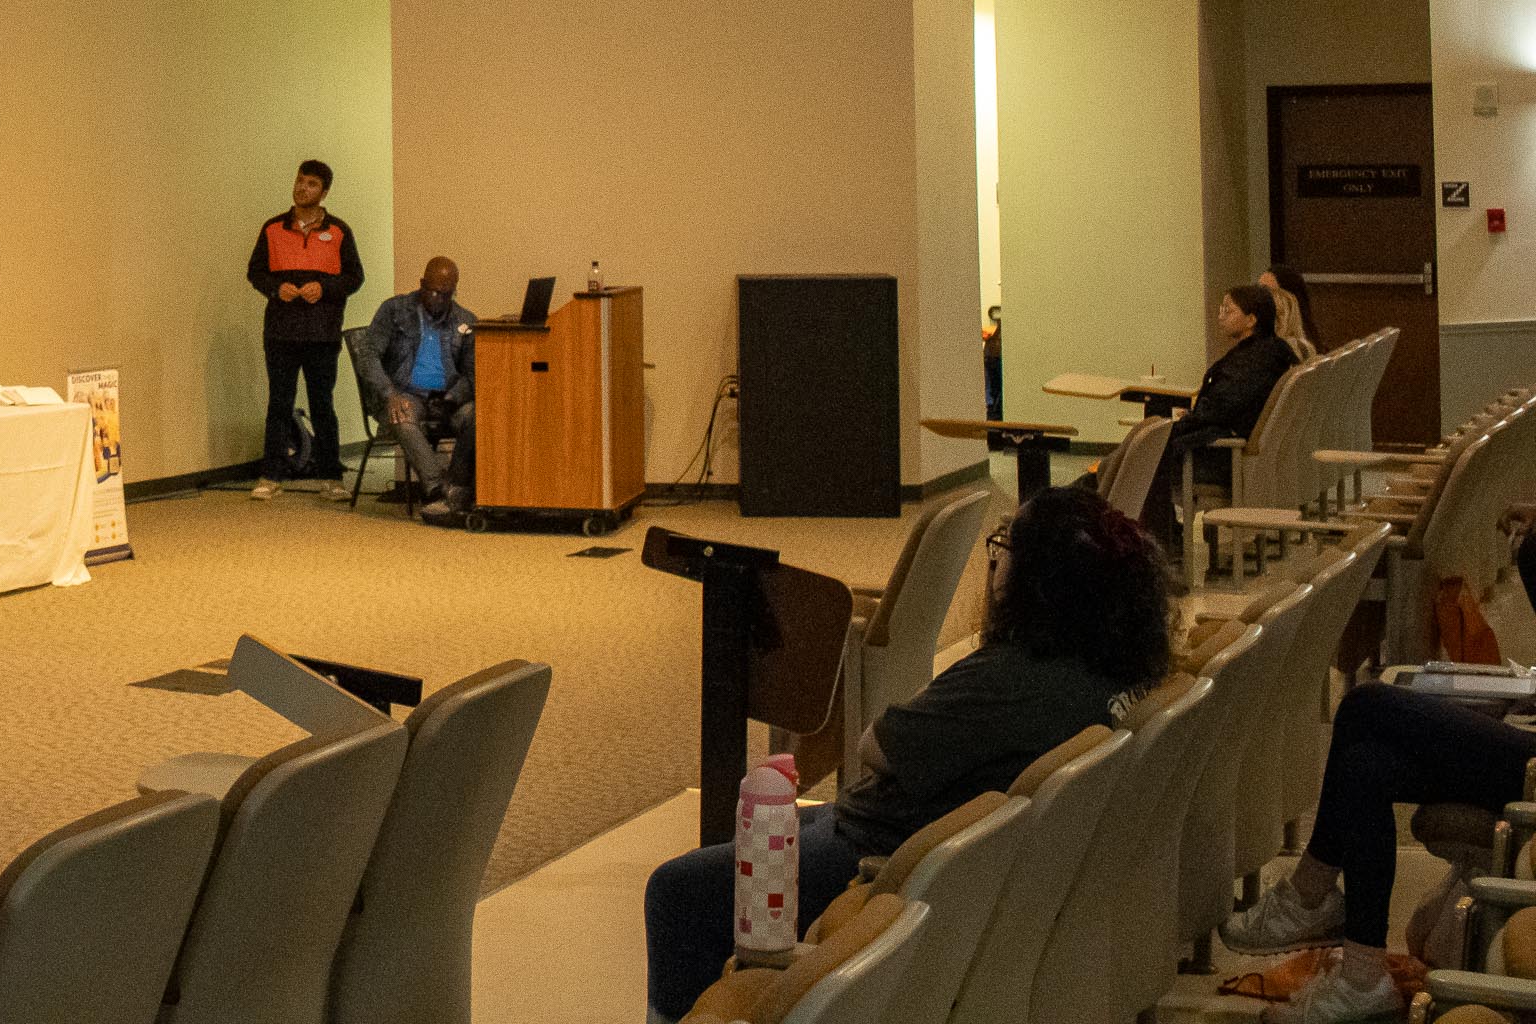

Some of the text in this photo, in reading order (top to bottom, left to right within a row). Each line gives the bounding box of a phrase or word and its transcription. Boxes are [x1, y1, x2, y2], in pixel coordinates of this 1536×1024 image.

[1308, 167, 1408, 179] EMERGENCY EXIT
[1342, 183, 1375, 193] ONLY
[71, 373, 102, 384] DISCOVER
